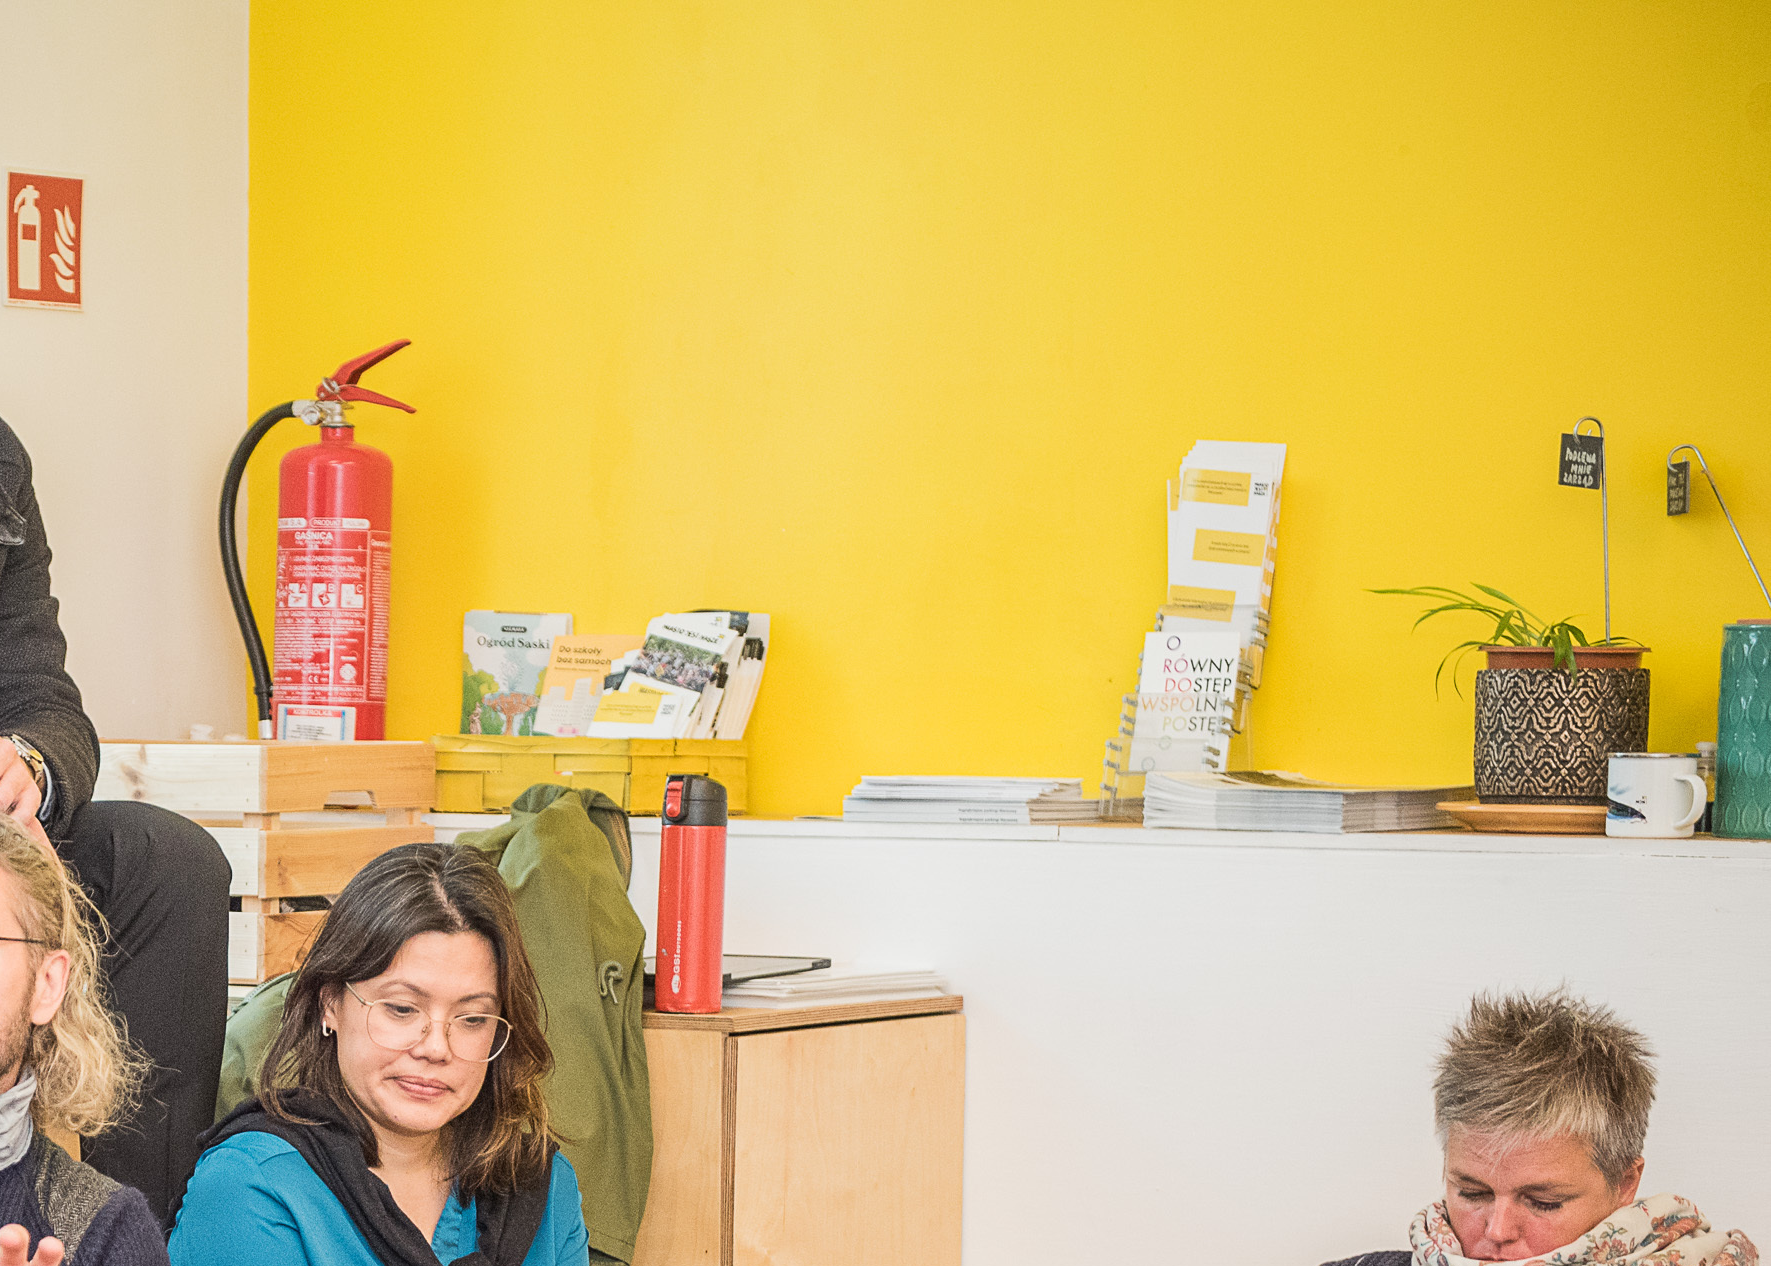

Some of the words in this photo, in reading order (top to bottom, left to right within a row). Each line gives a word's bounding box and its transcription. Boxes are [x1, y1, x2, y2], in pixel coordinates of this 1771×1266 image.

[294, 530, 333, 540] GAŚNICA
[356, 584, 364, 593] C
[477, 635, 515, 649] Ogród
[517, 637, 550, 650] Saski
[559, 645, 571, 653] Do
[573, 646, 602, 656] szkoły
[1166, 635, 1181, 651] O
[1163, 653, 1235, 674] RÓWNY
[1164, 677, 1232, 694] DOSTĘP
[1163, 716, 1221, 735] POSTĘ
[673, 953, 681, 974] GSI
